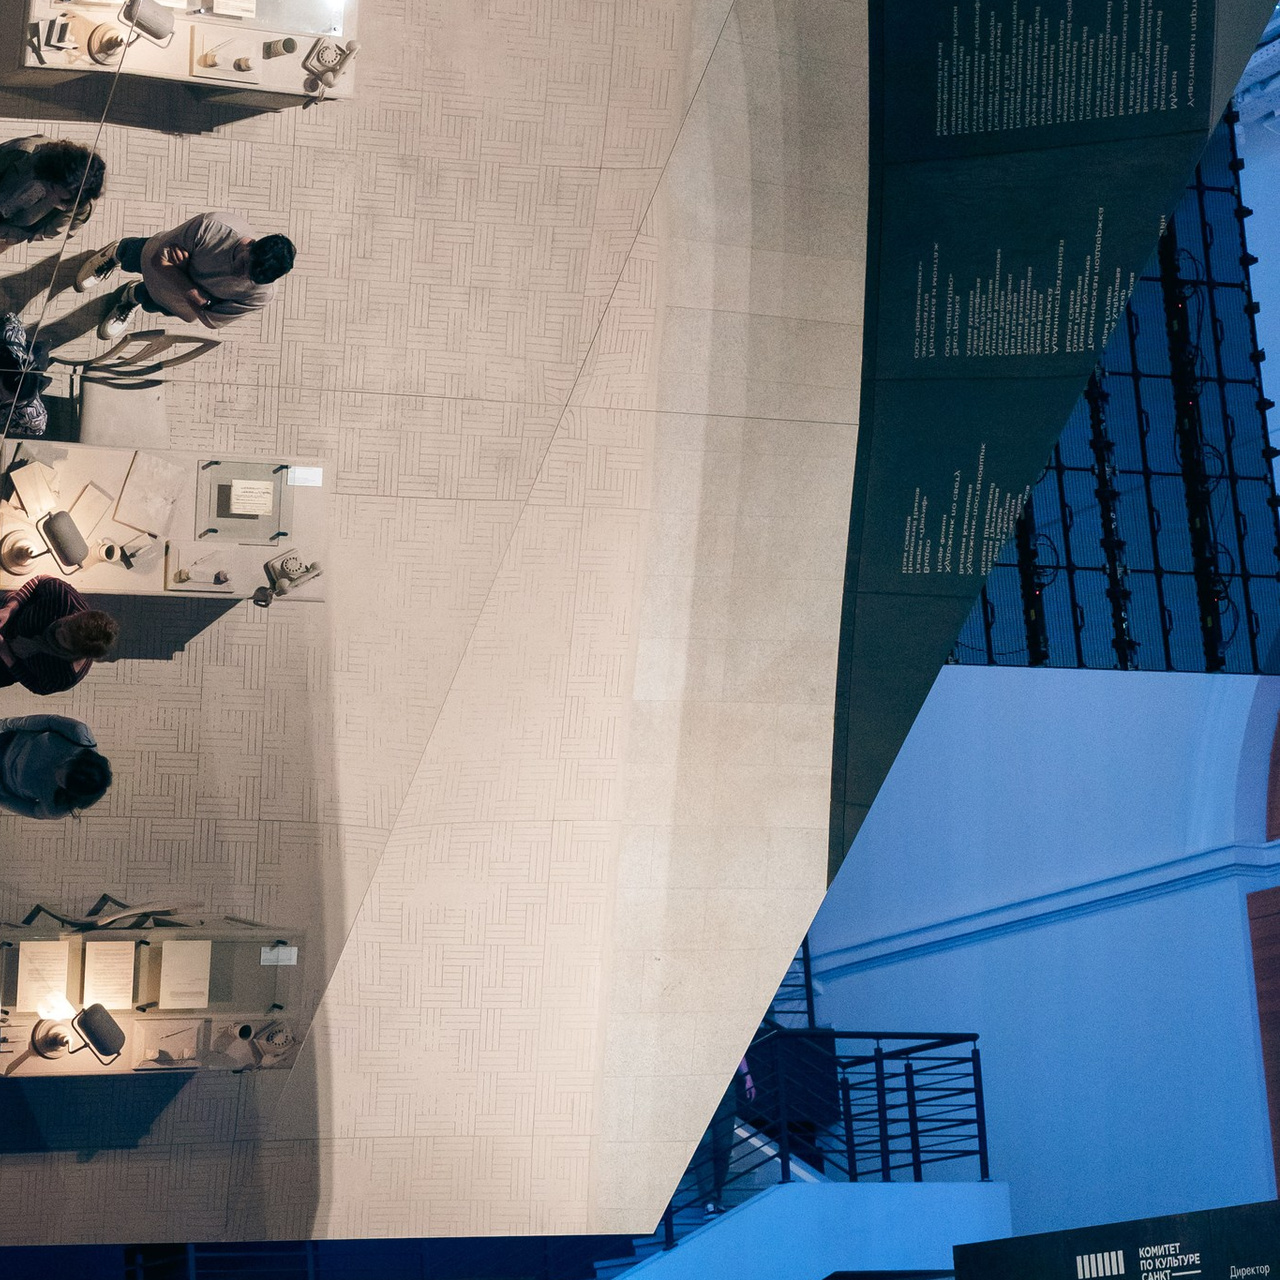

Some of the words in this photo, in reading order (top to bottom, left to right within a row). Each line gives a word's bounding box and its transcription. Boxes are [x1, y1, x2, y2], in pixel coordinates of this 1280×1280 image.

[1139, 1242, 1180, 1258] КОМИТЕТ
[1140, 1260, 1154, 1271] ПО
[1155, 1253, 1201, 1269] КУЛЬТУРЕ
[1230, 1264, 1270, 1279] Директор
